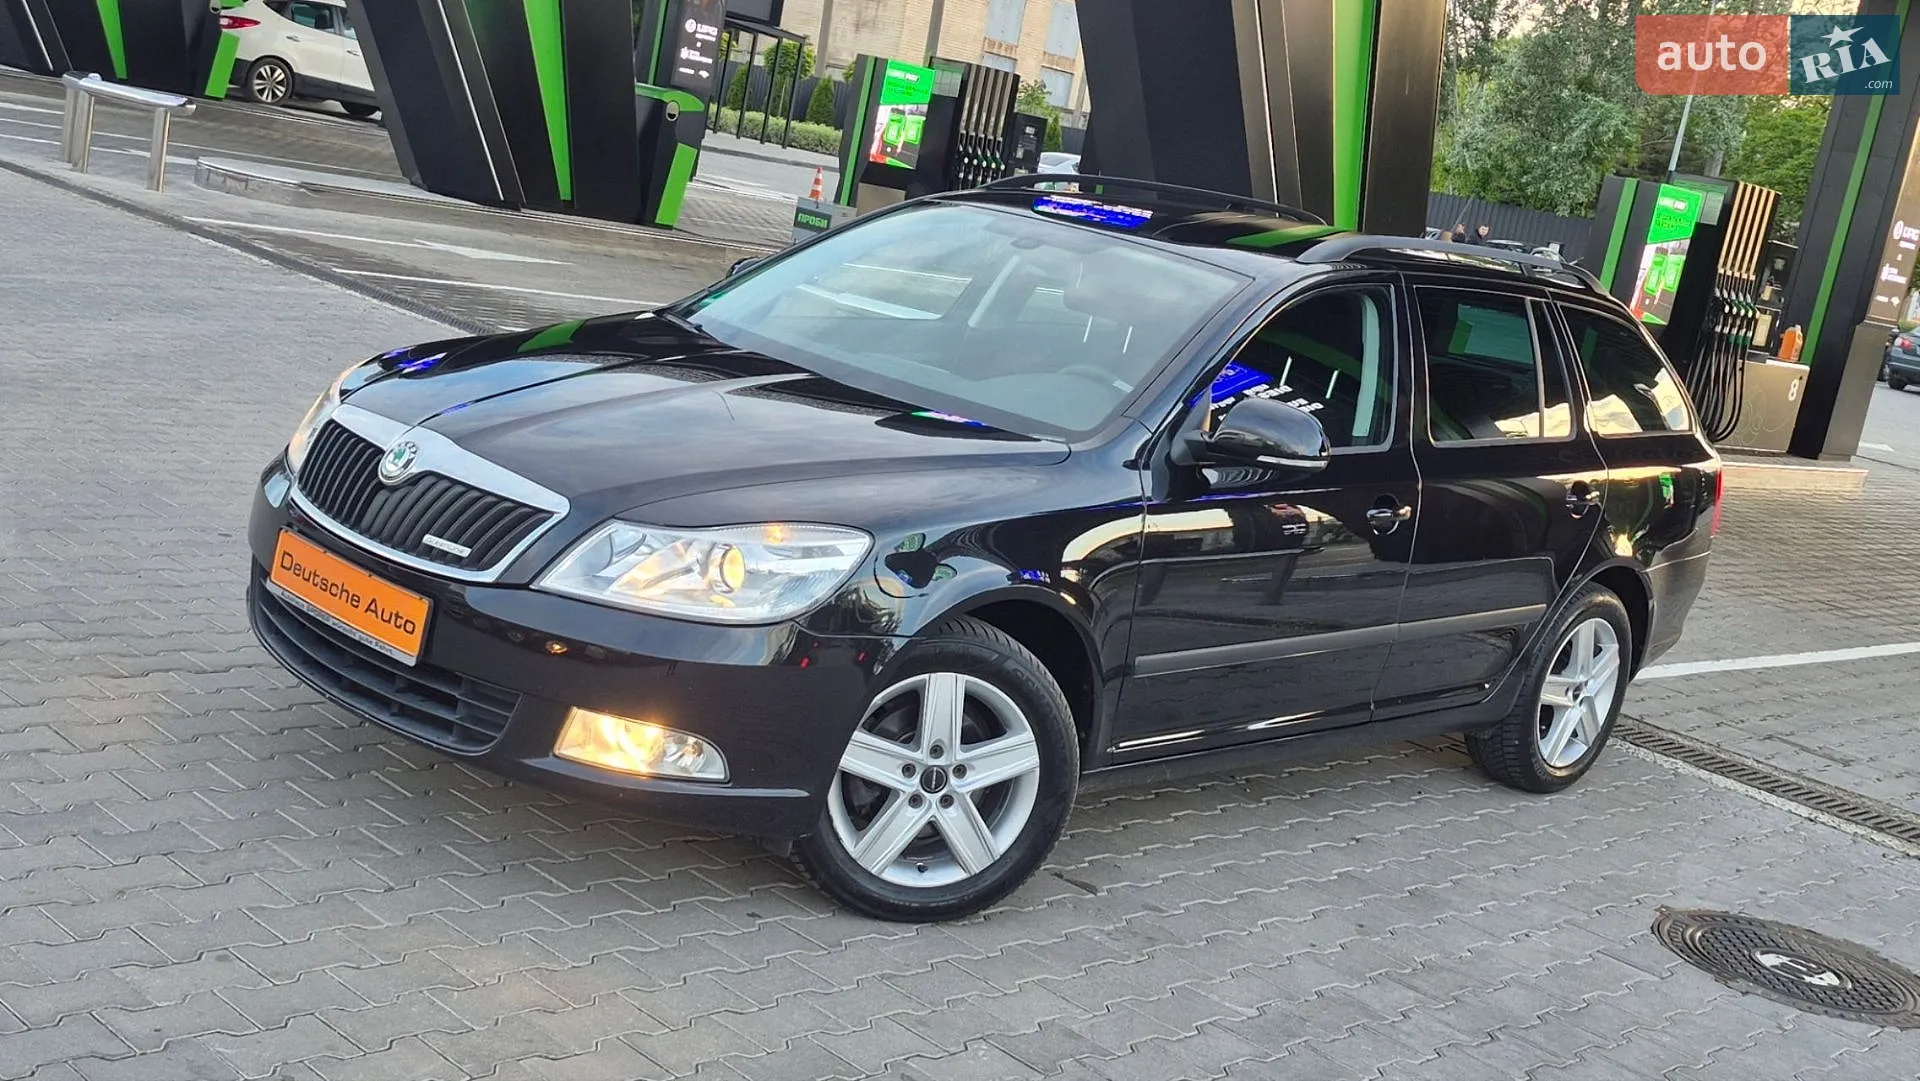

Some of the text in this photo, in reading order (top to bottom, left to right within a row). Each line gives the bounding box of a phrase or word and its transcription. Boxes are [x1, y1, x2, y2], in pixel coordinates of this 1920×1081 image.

[1787, 378, 1799, 401] 8
[280, 551, 361, 609] Deutsche
[363, 597, 417, 636] Auto
